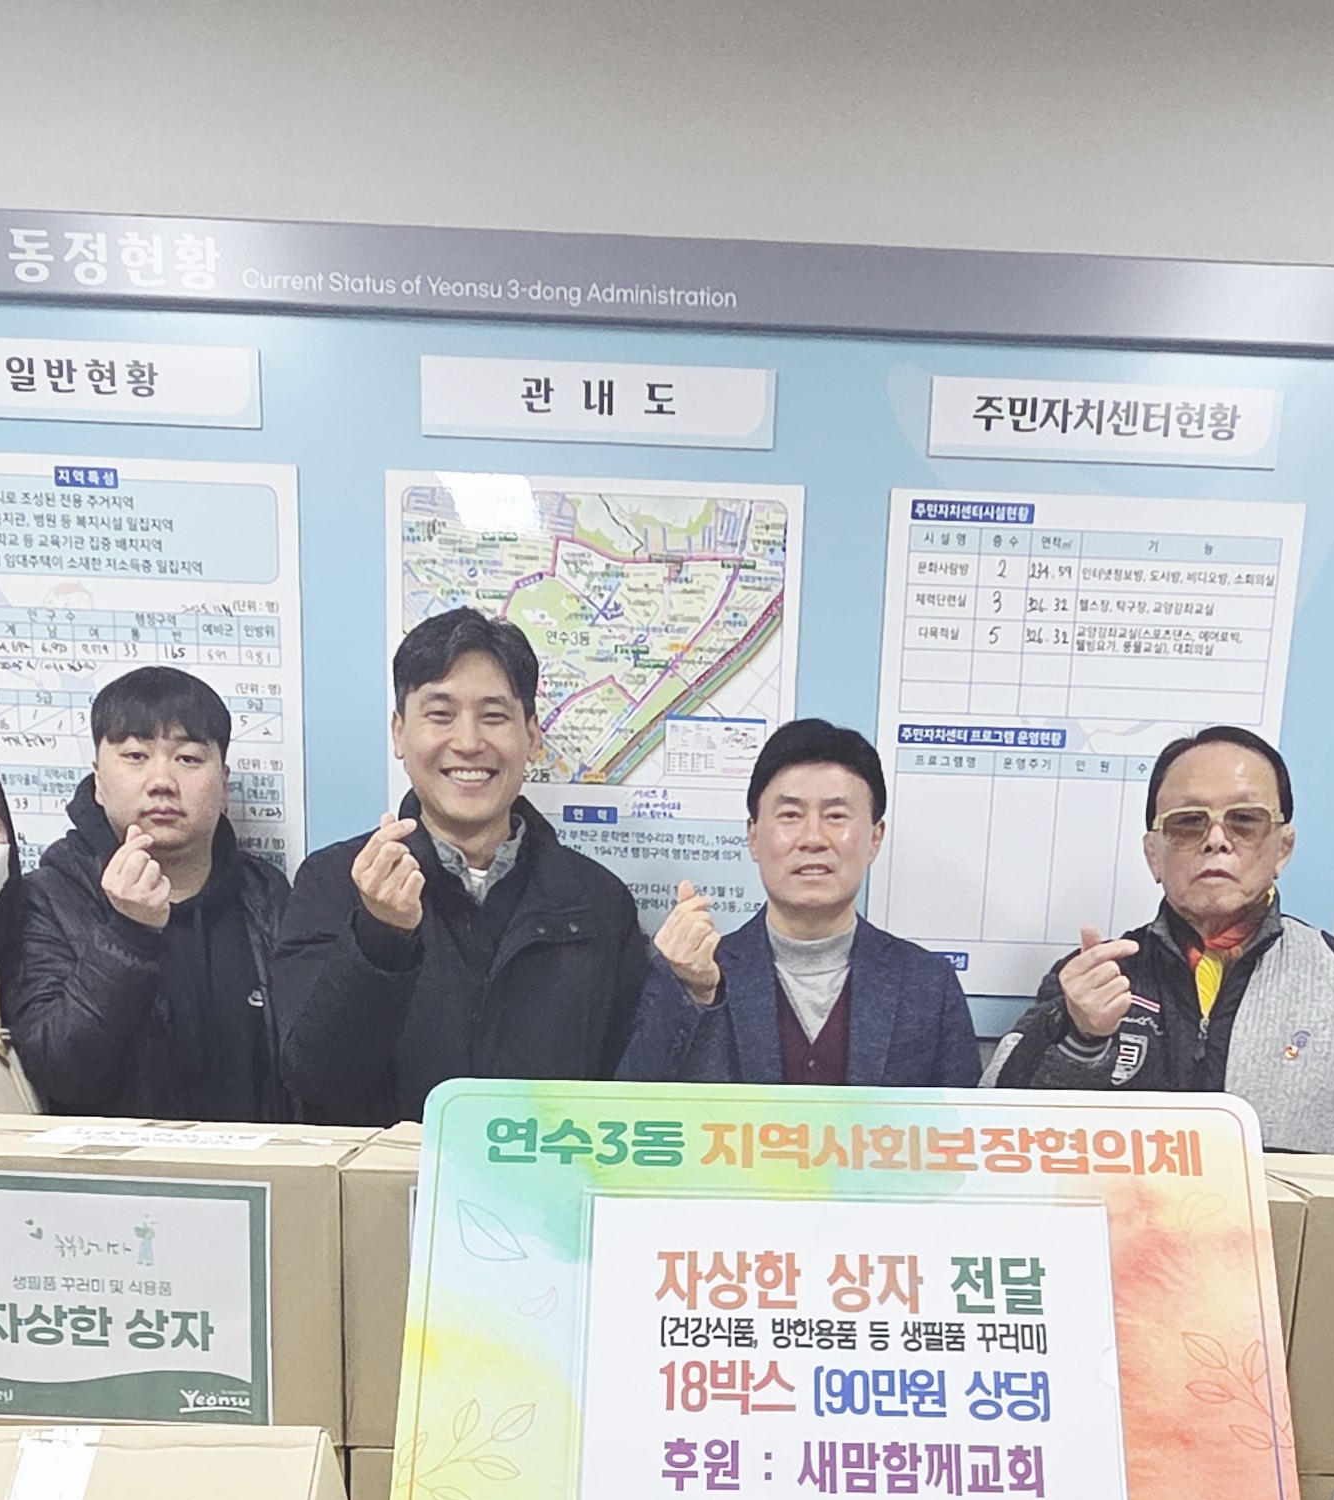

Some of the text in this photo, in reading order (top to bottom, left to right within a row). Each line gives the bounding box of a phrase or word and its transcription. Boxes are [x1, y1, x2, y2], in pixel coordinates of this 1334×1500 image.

[8, 227, 221, 291] 동정현황
[242, 269, 737, 308] Current Status of Yeonsu 3-dong Administration
[6, 357, 159, 397] 일반현황
[972, 395, 1240, 441] 주민자치센터현황
[58, 469, 115, 486] 지역특성
[87, 495, 134, 510] 주거지역
[915, 503, 1029, 521] 주민자치센터시설현황
[34, 513, 56, 528] 병원
[77, 516, 122, 531] 복지시설
[38, 536, 85, 550] 교육기관
[997, 559, 1006, 578] 2
[916, 593, 966, 608] 체력단련실
[993, 591, 1001, 612] 3
[546, 630, 590, 646] 연수3동
[919, 627, 959, 640] 다목적실
[989, 626, 1001, 644] 5
[901, 728, 1062, 746] 주민자치센터 프로그램 운영현황
[710, 887, 744, 897] 3월 1일
[486, 1119, 1203, 1176] 연수3동 지역사회보장협의체
[13, 1275, 172, 1296] 생필품 꾸러미 및 식용품
[655, 1251, 1044, 1315] 자상한 상자 전달
[125, 1308, 214, 1352] 상자
[772, 1320, 858, 1351] 방한용품
[869, 1323, 889, 1352] 등
[899, 1323, 966, 1354] 생필품
[180, 1388, 250, 1410] Yeonsu
[660, 1362, 796, 1416] 18박스
[662, 1439, 1046, 1498] 후원 : 새맘함께교회
